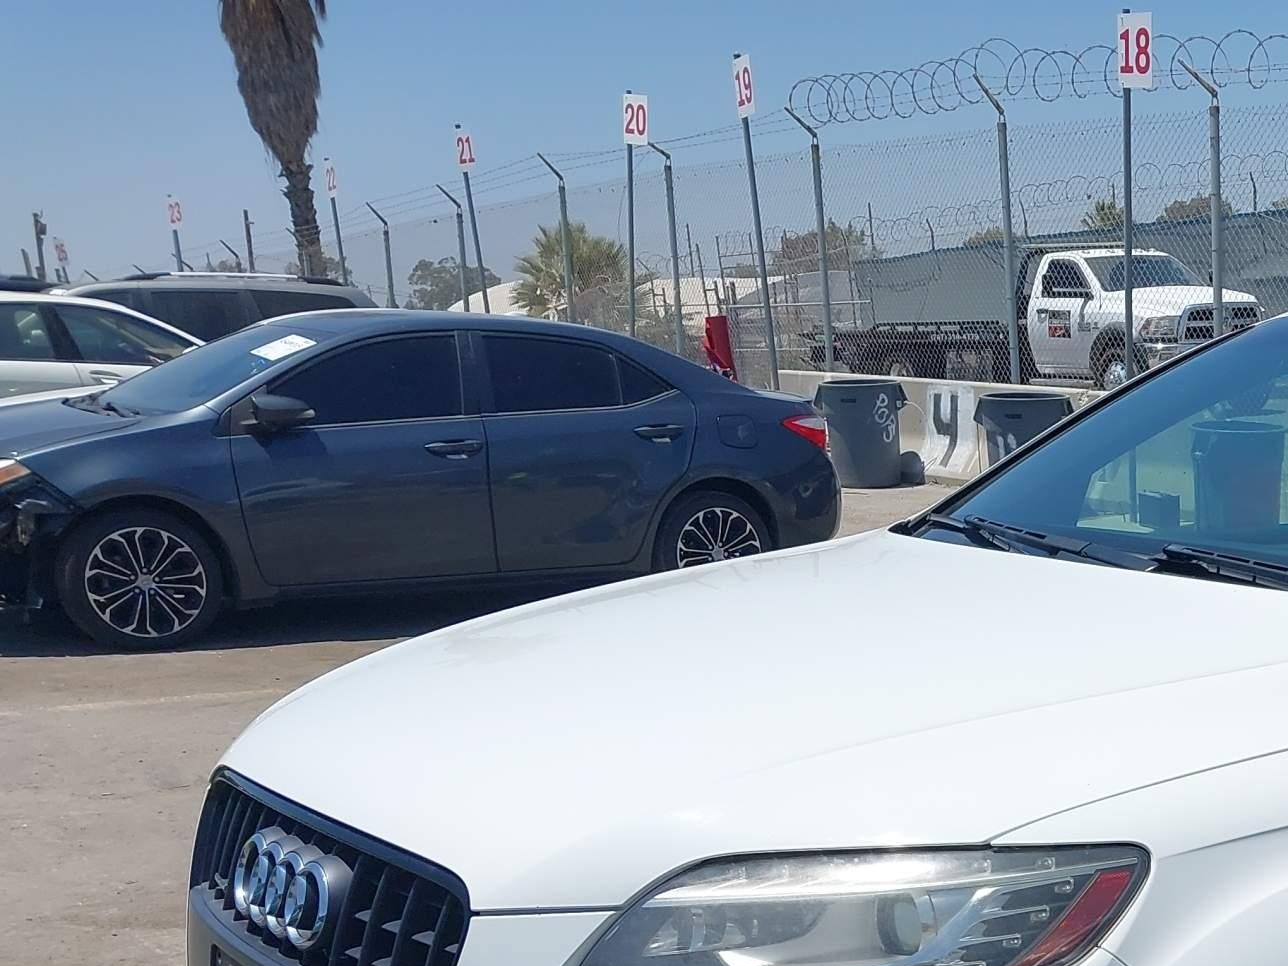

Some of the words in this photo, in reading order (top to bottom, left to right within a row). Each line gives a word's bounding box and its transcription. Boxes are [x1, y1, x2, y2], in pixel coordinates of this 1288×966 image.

[1119, 27, 1150, 74] 18
[735, 66, 753, 107] 19
[625, 103, 646, 136] 20
[456, 136, 475, 164] 21
[326, 167, 336, 191] 22
[168, 202, 182, 223] 23
